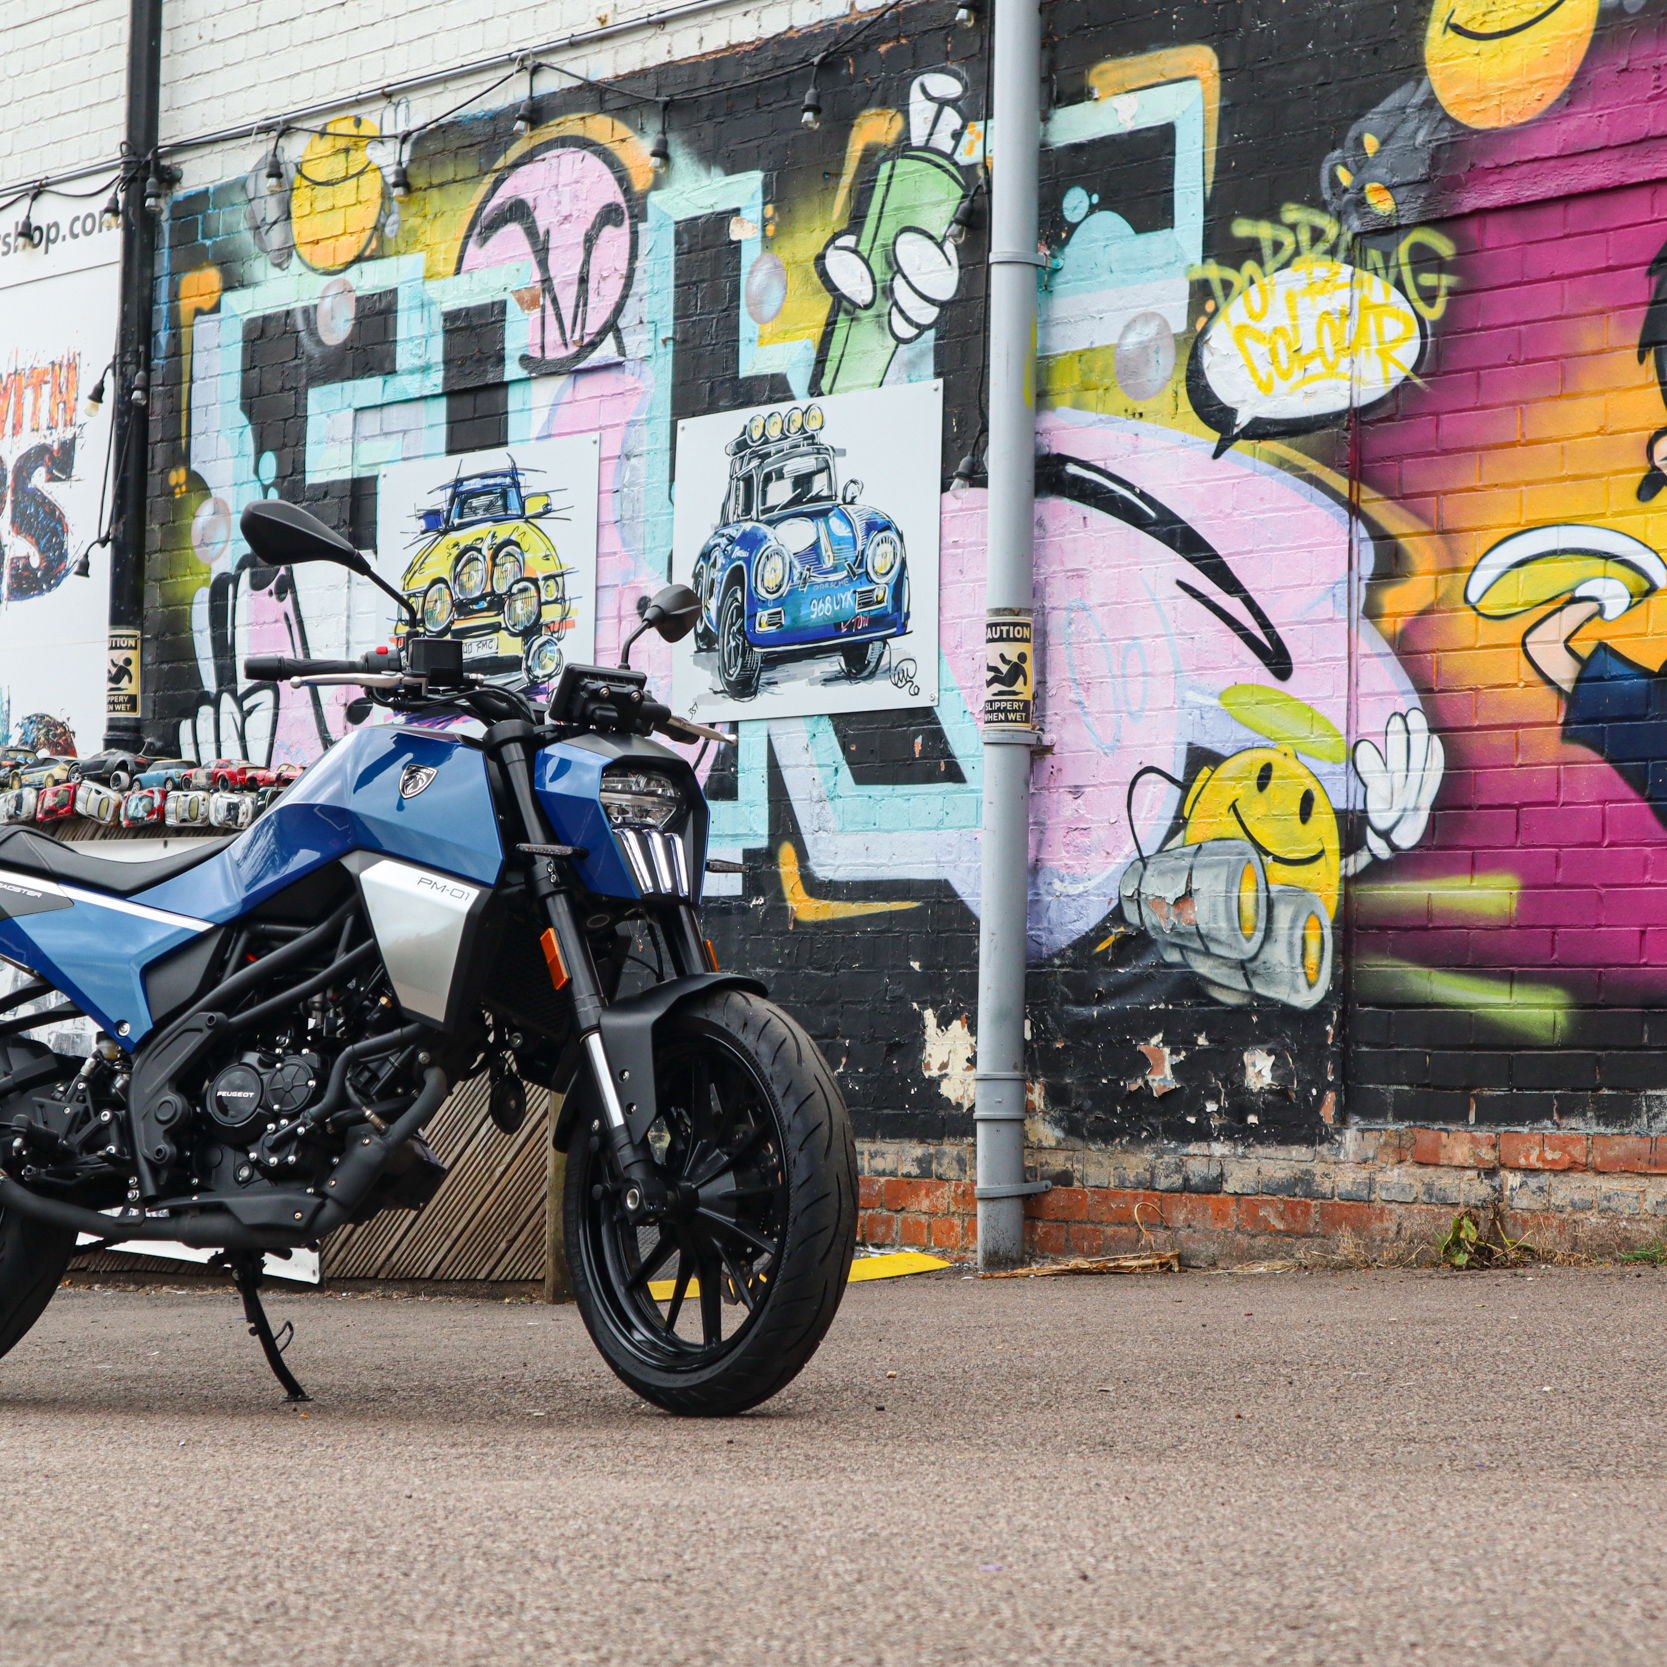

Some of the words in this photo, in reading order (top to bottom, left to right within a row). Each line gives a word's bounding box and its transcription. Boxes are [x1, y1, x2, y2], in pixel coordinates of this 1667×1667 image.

[1233, 289, 1432, 396] COLOUR
[985, 625, 1031, 640] AUTION
[115, 703, 131, 712] WET
[985, 701, 1025, 711] SLIPPERY
[1007, 711, 1027, 722] WET
[417, 877, 470, 901] PM-01
